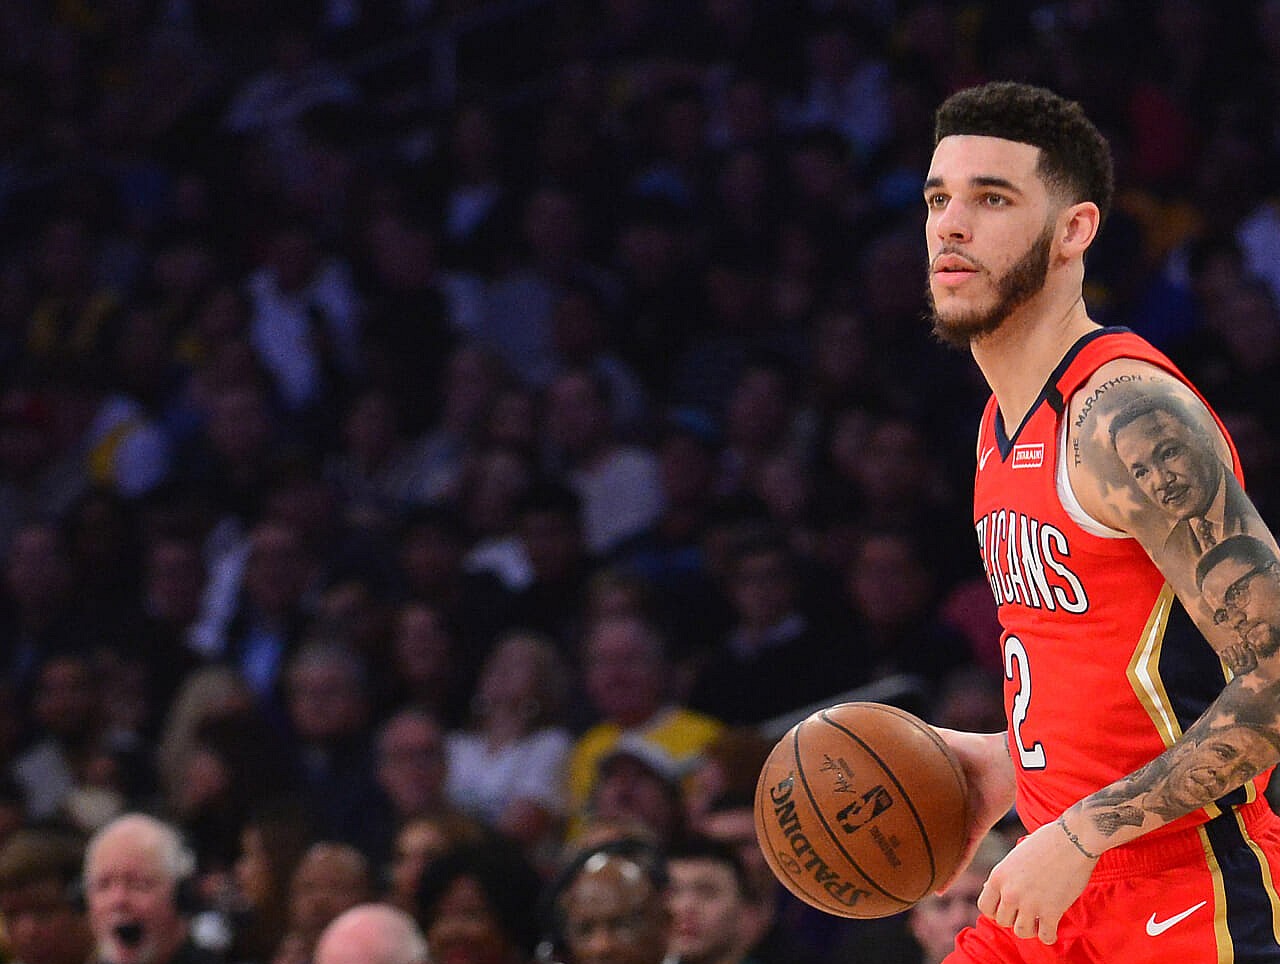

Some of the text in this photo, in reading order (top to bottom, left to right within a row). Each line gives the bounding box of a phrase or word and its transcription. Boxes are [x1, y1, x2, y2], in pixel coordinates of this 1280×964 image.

[1075, 374, 1143, 428] MARATHON
[1003, 632, 1047, 771] 2
[769, 772, 872, 907] SPALDING
